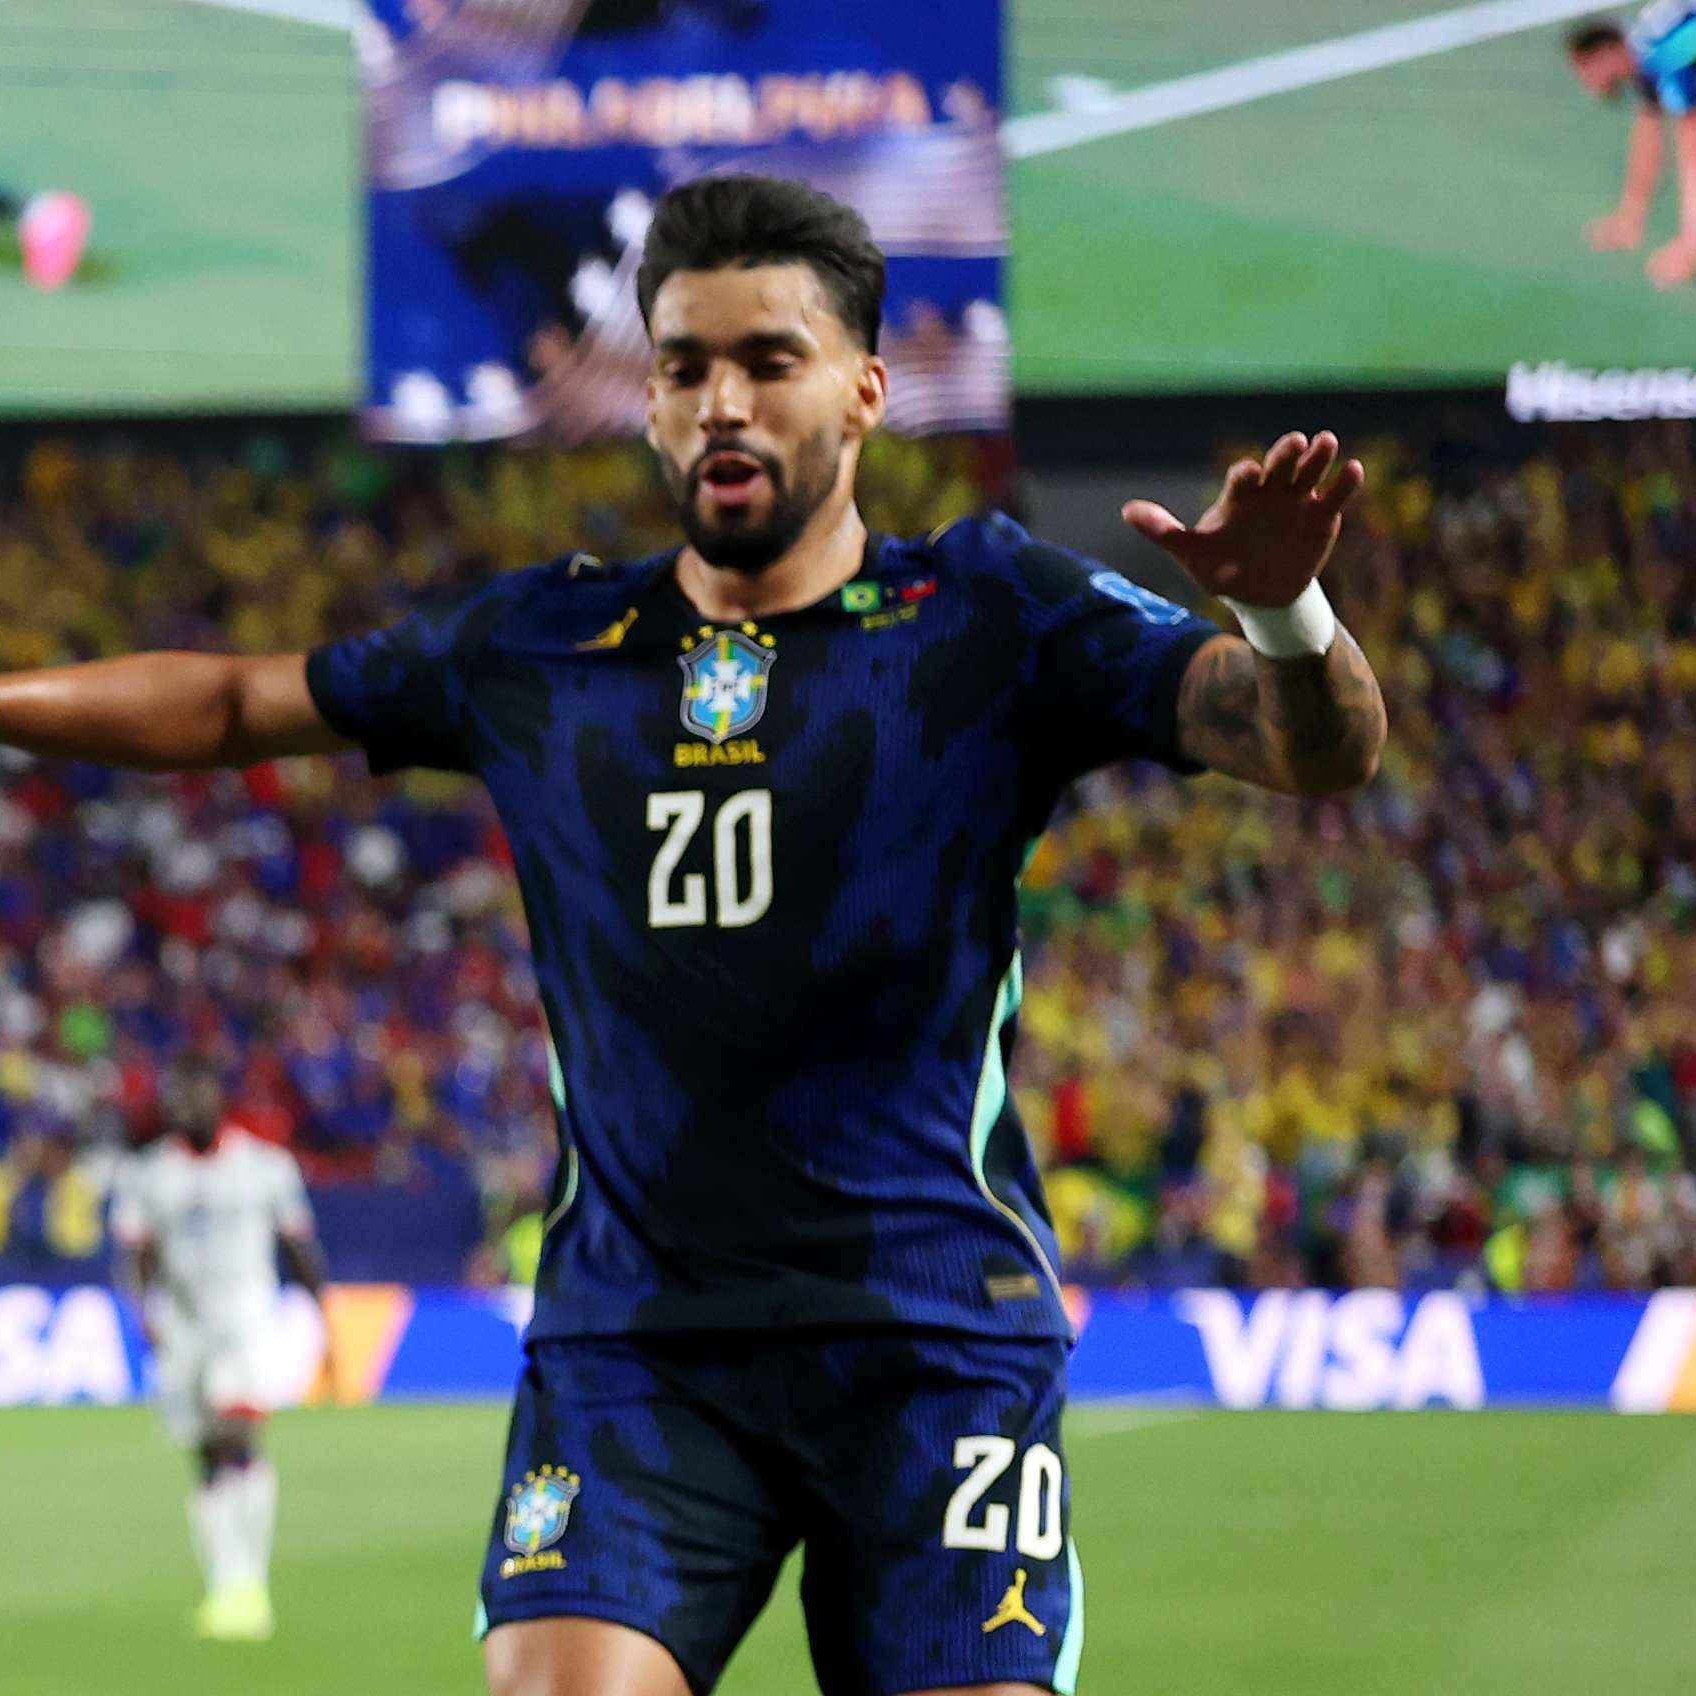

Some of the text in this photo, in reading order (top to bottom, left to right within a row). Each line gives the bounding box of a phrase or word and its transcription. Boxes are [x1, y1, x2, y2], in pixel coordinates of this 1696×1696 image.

[672, 739, 766, 768] BRASIL
[645, 787, 774, 929] 20
[1171, 1286, 1487, 1411] VISA
[942, 1434, 1063, 1561] 20
